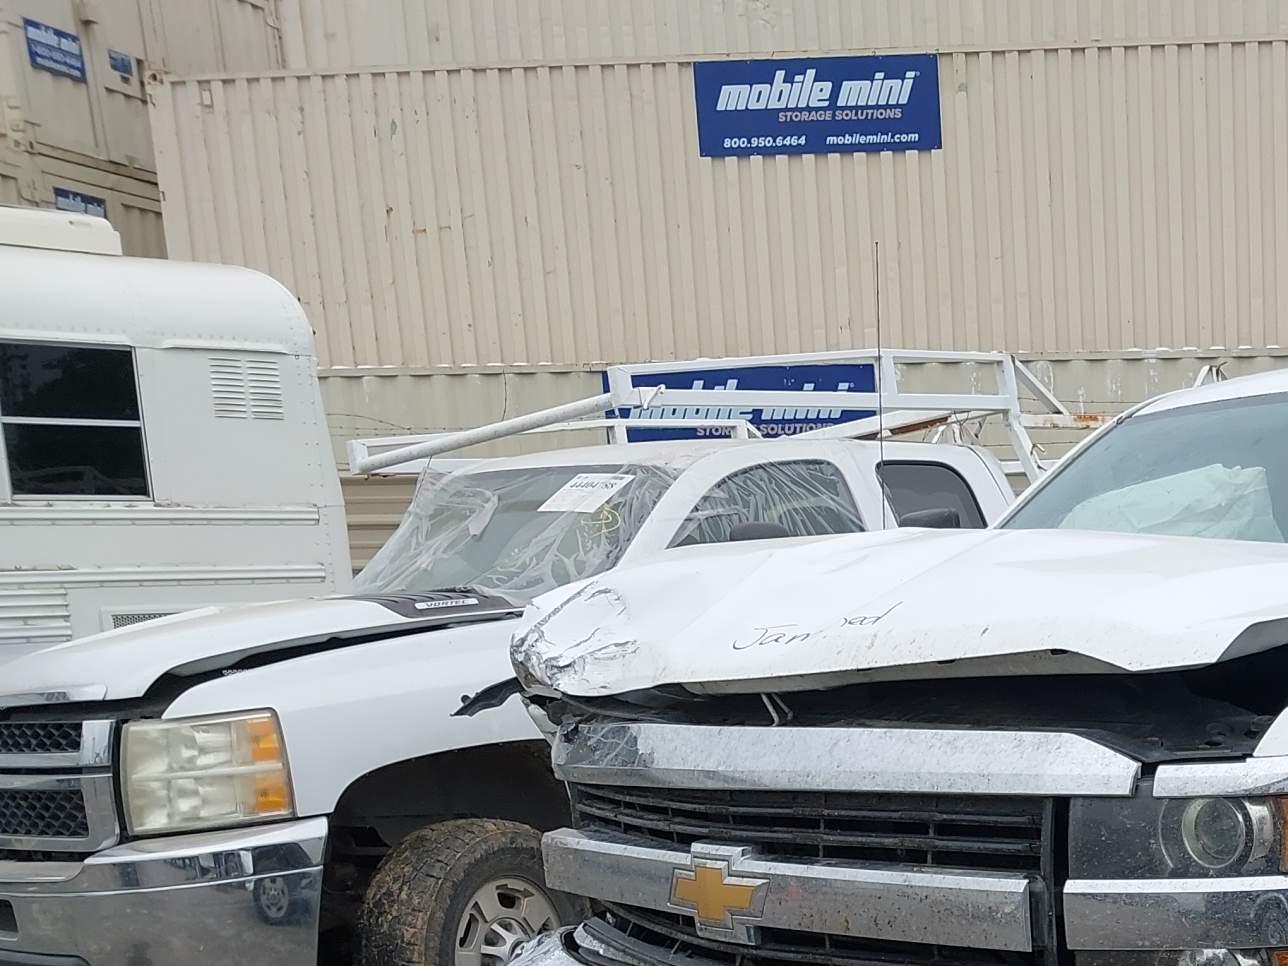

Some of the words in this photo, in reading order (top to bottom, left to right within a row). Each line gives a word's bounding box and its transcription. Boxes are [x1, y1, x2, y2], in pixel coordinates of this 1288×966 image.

[716, 68, 833, 111] mobile
[836, 70, 916, 107] mini
[778, 111, 832, 122] STORAGE
[835, 108, 902, 121] SOLUTIONS
[723, 135, 806, 148] 800.950.6464
[826, 131, 919, 145] mobilemini.com
